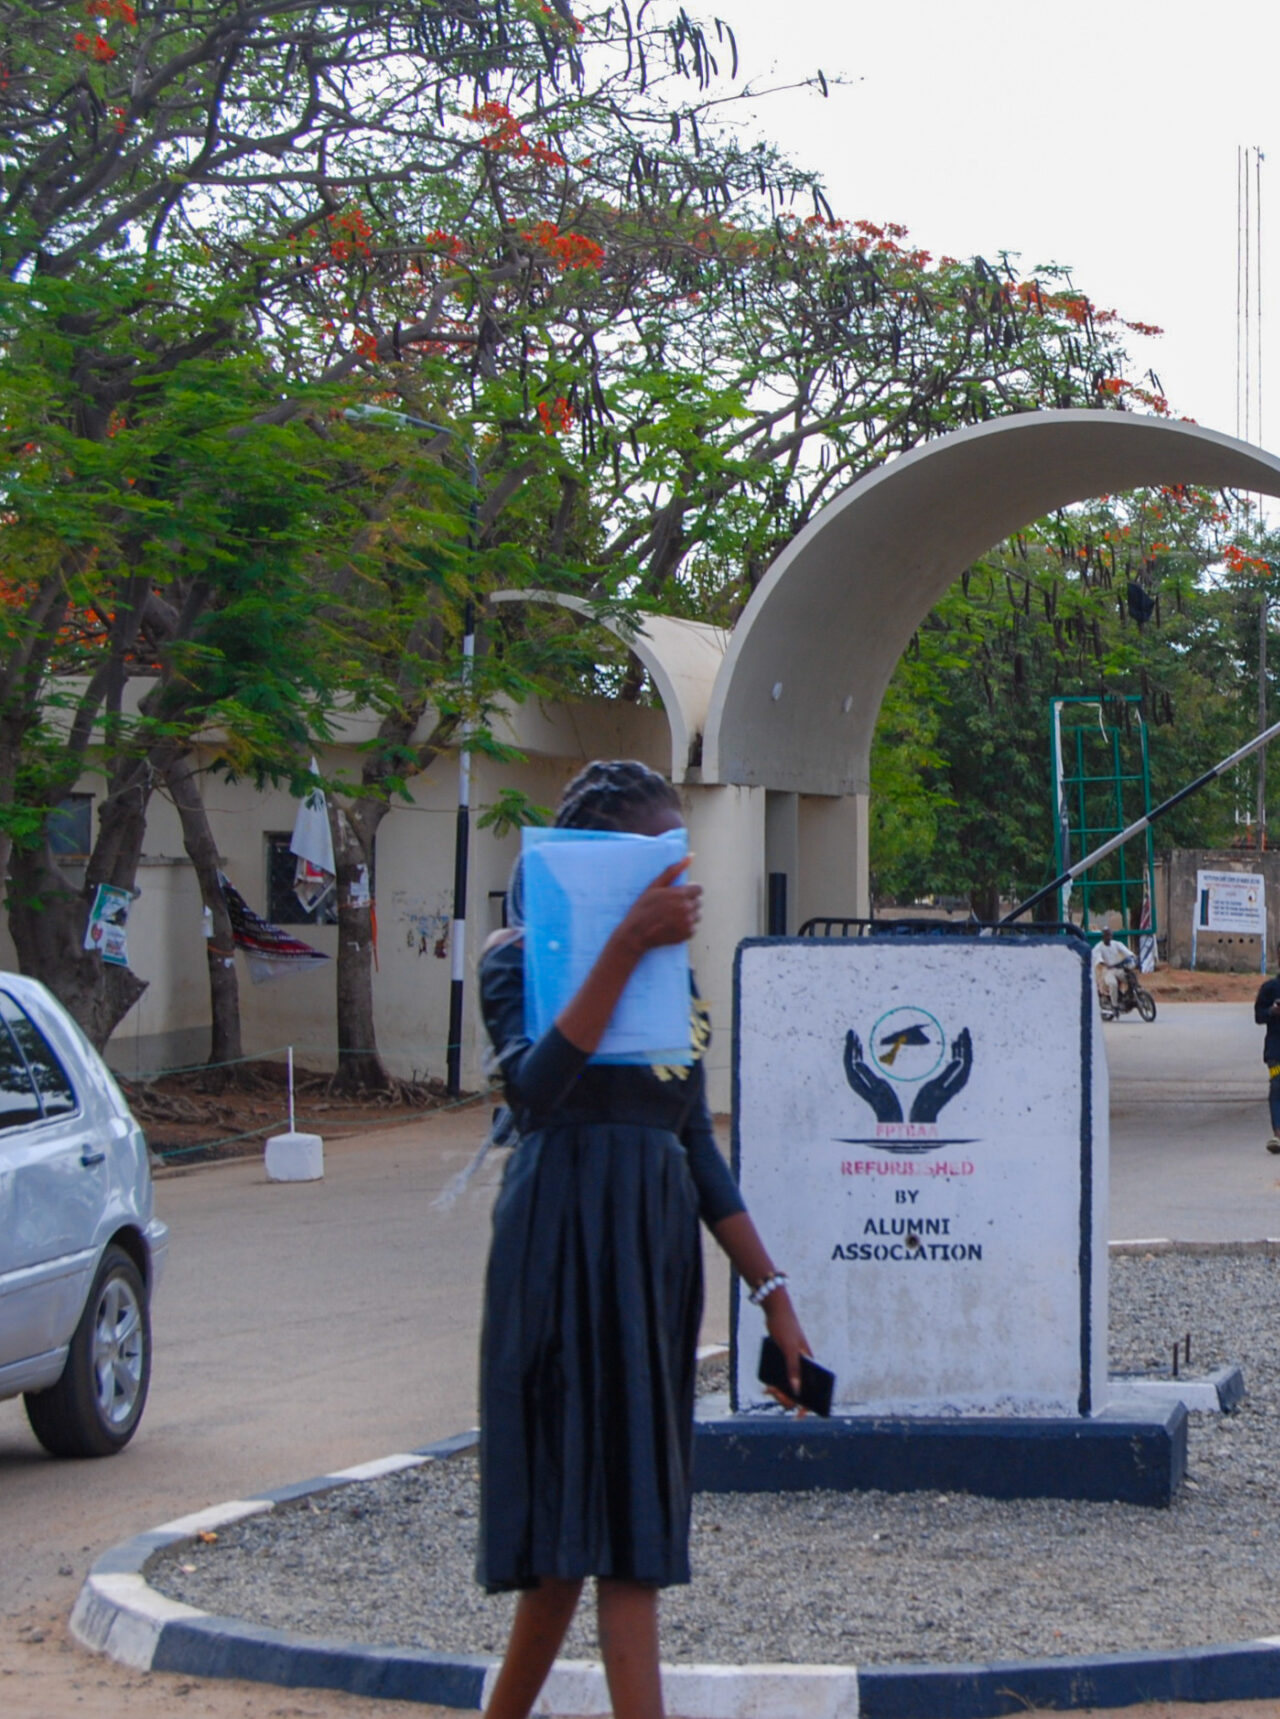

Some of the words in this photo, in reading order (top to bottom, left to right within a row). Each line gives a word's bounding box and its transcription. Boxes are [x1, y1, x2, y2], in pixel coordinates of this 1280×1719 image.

[841, 1160, 975, 1177] REFURBSHED
[895, 1190, 920, 1204] BY
[863, 1218, 951, 1236] ALUMNI
[831, 1244, 983, 1262] ASSOCIATION
